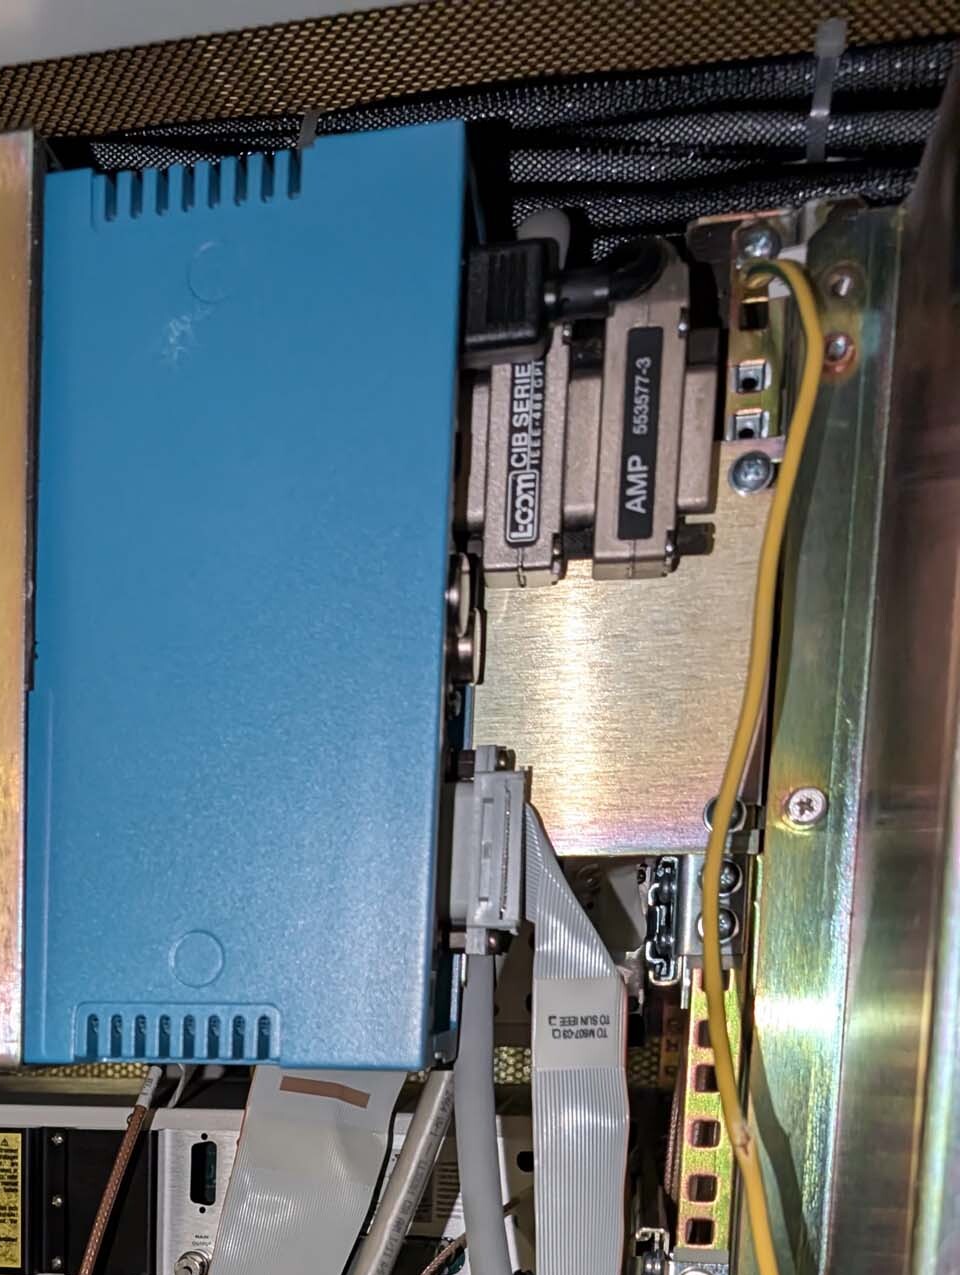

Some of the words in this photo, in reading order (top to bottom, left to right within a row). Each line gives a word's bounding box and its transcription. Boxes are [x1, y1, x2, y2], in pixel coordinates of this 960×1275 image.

[513, 363, 531, 427] SERIE
[633, 356, 652, 435] 553577-3
[511, 432, 529, 467] CIB
[625, 455, 649, 514] AMP
